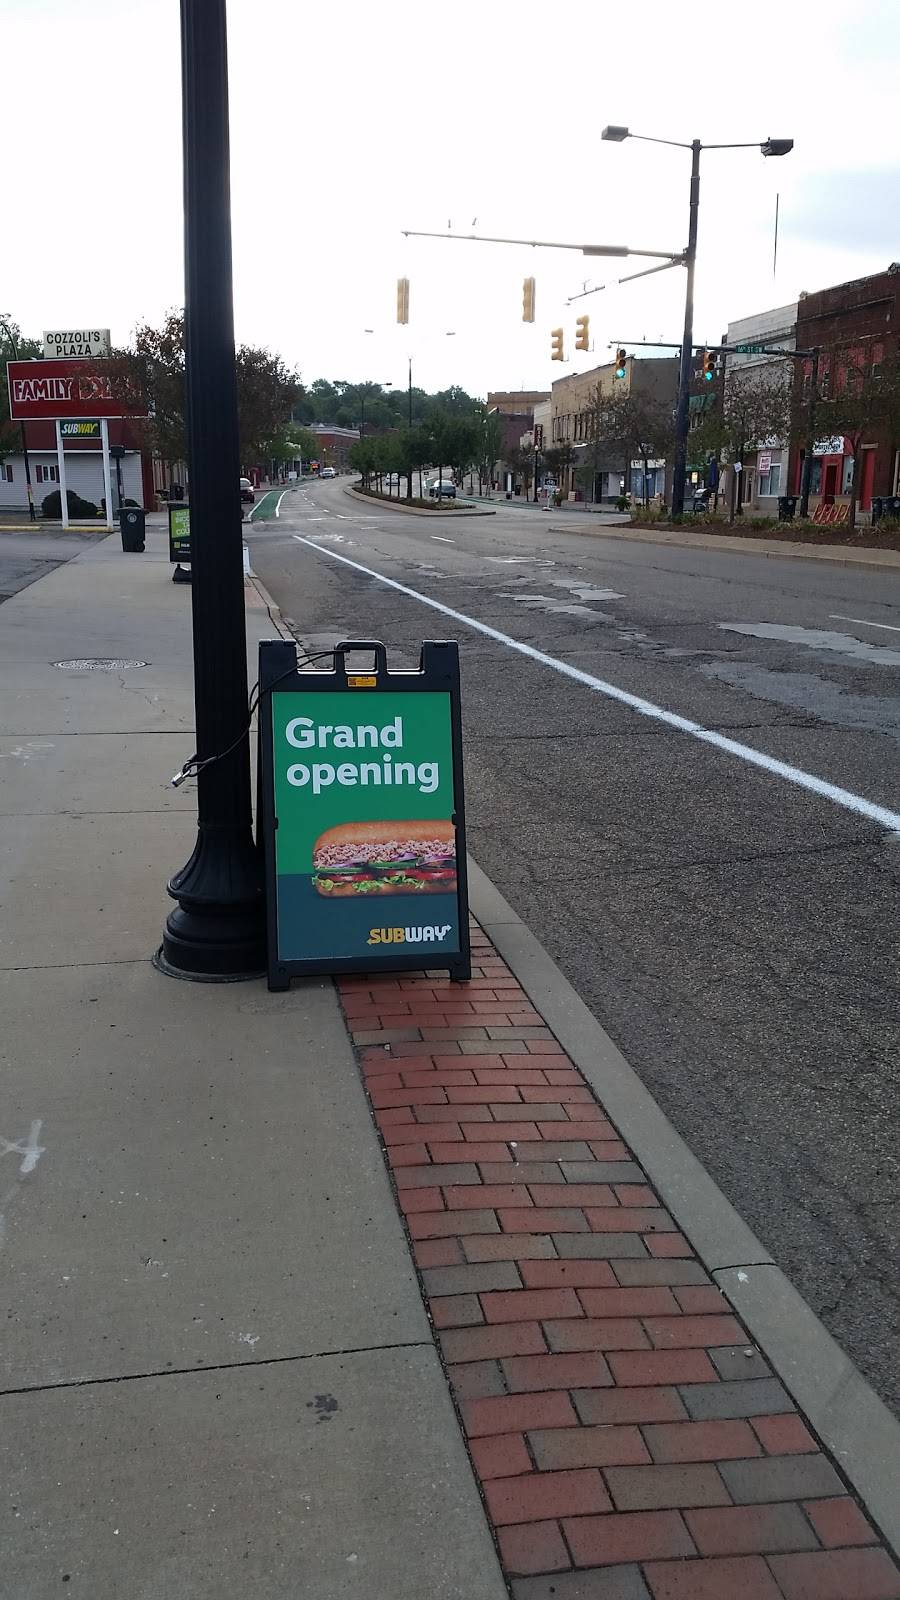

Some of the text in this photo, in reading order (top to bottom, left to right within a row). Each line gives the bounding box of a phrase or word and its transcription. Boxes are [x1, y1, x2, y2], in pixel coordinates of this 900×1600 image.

[46, 331, 101, 345] COZZOLI'S
[56, 344, 92, 356] PLAZA
[13, 377, 73, 402] FAMILY
[61, 423, 98, 434] SUBWAY
[285, 716, 403, 749] Grand
[286, 753, 440, 794] opening
[366, 923, 452, 945] SUBWAY
